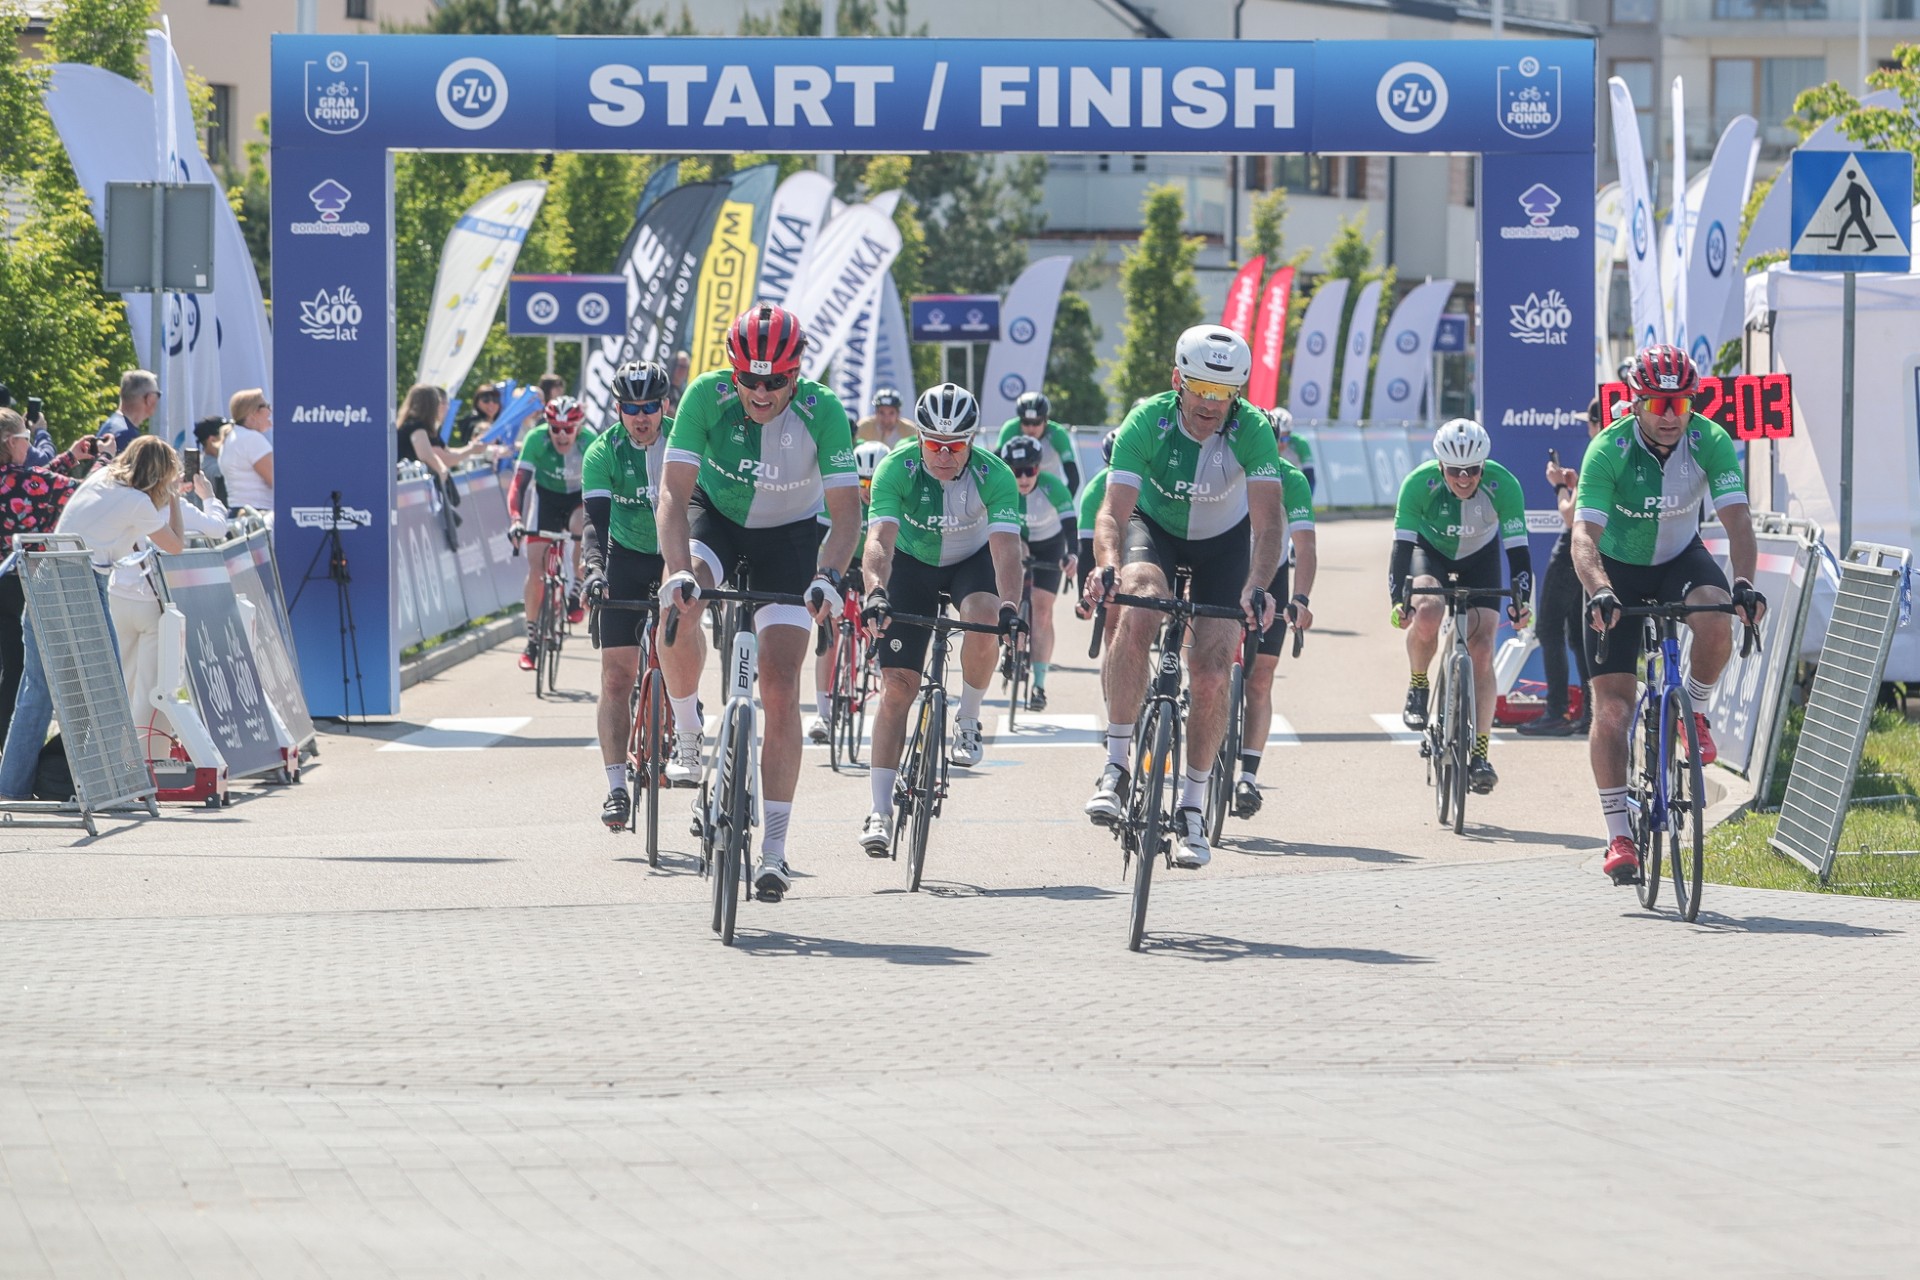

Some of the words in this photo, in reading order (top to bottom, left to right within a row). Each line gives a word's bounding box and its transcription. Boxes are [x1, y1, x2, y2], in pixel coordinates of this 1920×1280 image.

[452, 78, 492, 109] PZU
[588, 63, 895, 127] START
[922, 61, 949, 131] /
[981, 65, 1296, 129] FINISH
[1392, 83, 1432, 113] PZU
[319, 97, 354, 108] GRAN
[1511, 102, 1547, 112] GRAN
[315, 108, 359, 119] FONDO
[1507, 112, 1551, 124] FONDO
[641, 253, 674, 311] MOVE
[671, 252, 697, 310] MOVE
[315, 304, 362, 325] 600
[1525, 308, 1572, 329] 600
[336, 325, 358, 341] lat
[1545, 329, 1567, 344] lat
[1212, 351, 1228, 361] 266
[753, 361, 768, 370] 249
[1661, 376, 1677, 384] 262
[292, 404, 368, 427] Activejet
[939, 418, 952, 427] 260
[708, 457, 748, 484] GRAN
[753, 478, 811, 493] FONDO
[737, 459, 779, 480] PZU
[1175, 480, 1211, 494] PZU
[1643, 495, 1679, 509] PZU
[1615, 503, 1655, 519] GRAN
[927, 515, 959, 527] PZU
[1446, 525, 1475, 536] PZU
[738, 646, 750, 689] BMC
